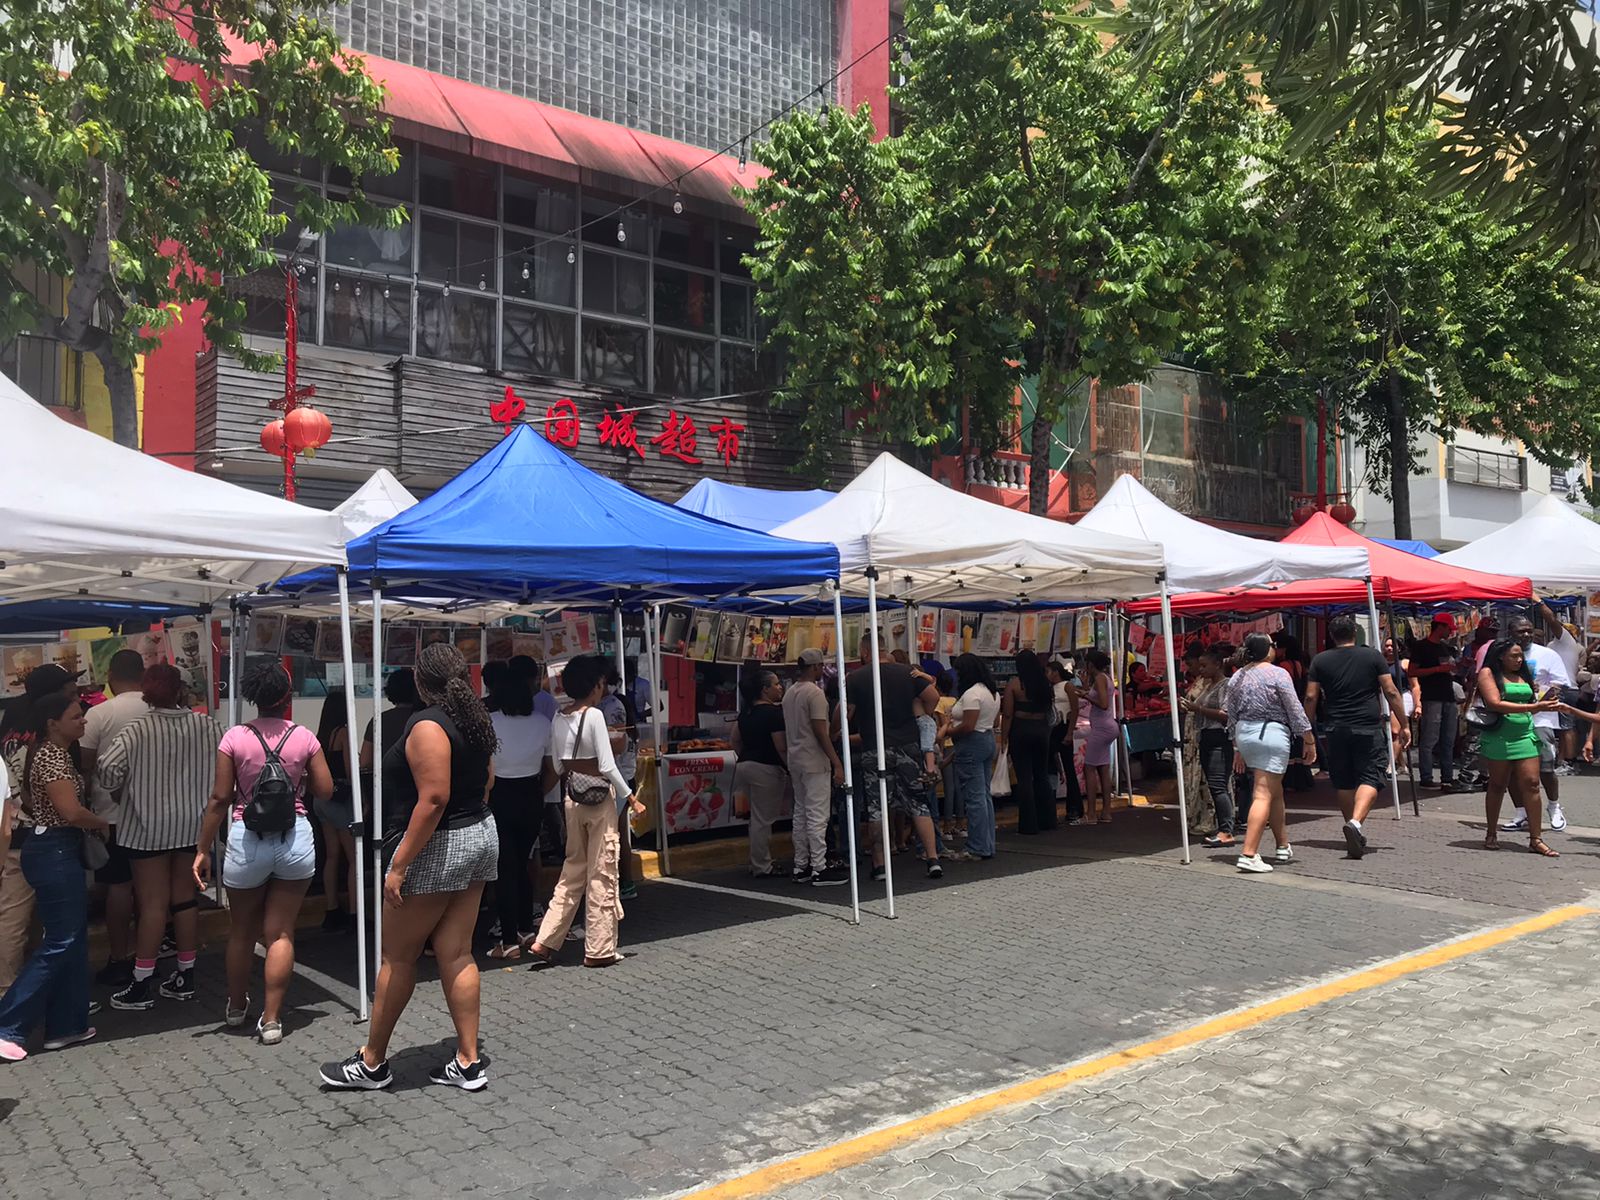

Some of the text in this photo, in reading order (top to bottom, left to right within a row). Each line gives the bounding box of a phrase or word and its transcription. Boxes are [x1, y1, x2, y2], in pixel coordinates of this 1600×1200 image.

[490, 385, 745, 467] 中国城超市
[674, 765, 719, 775] CON CREMA
